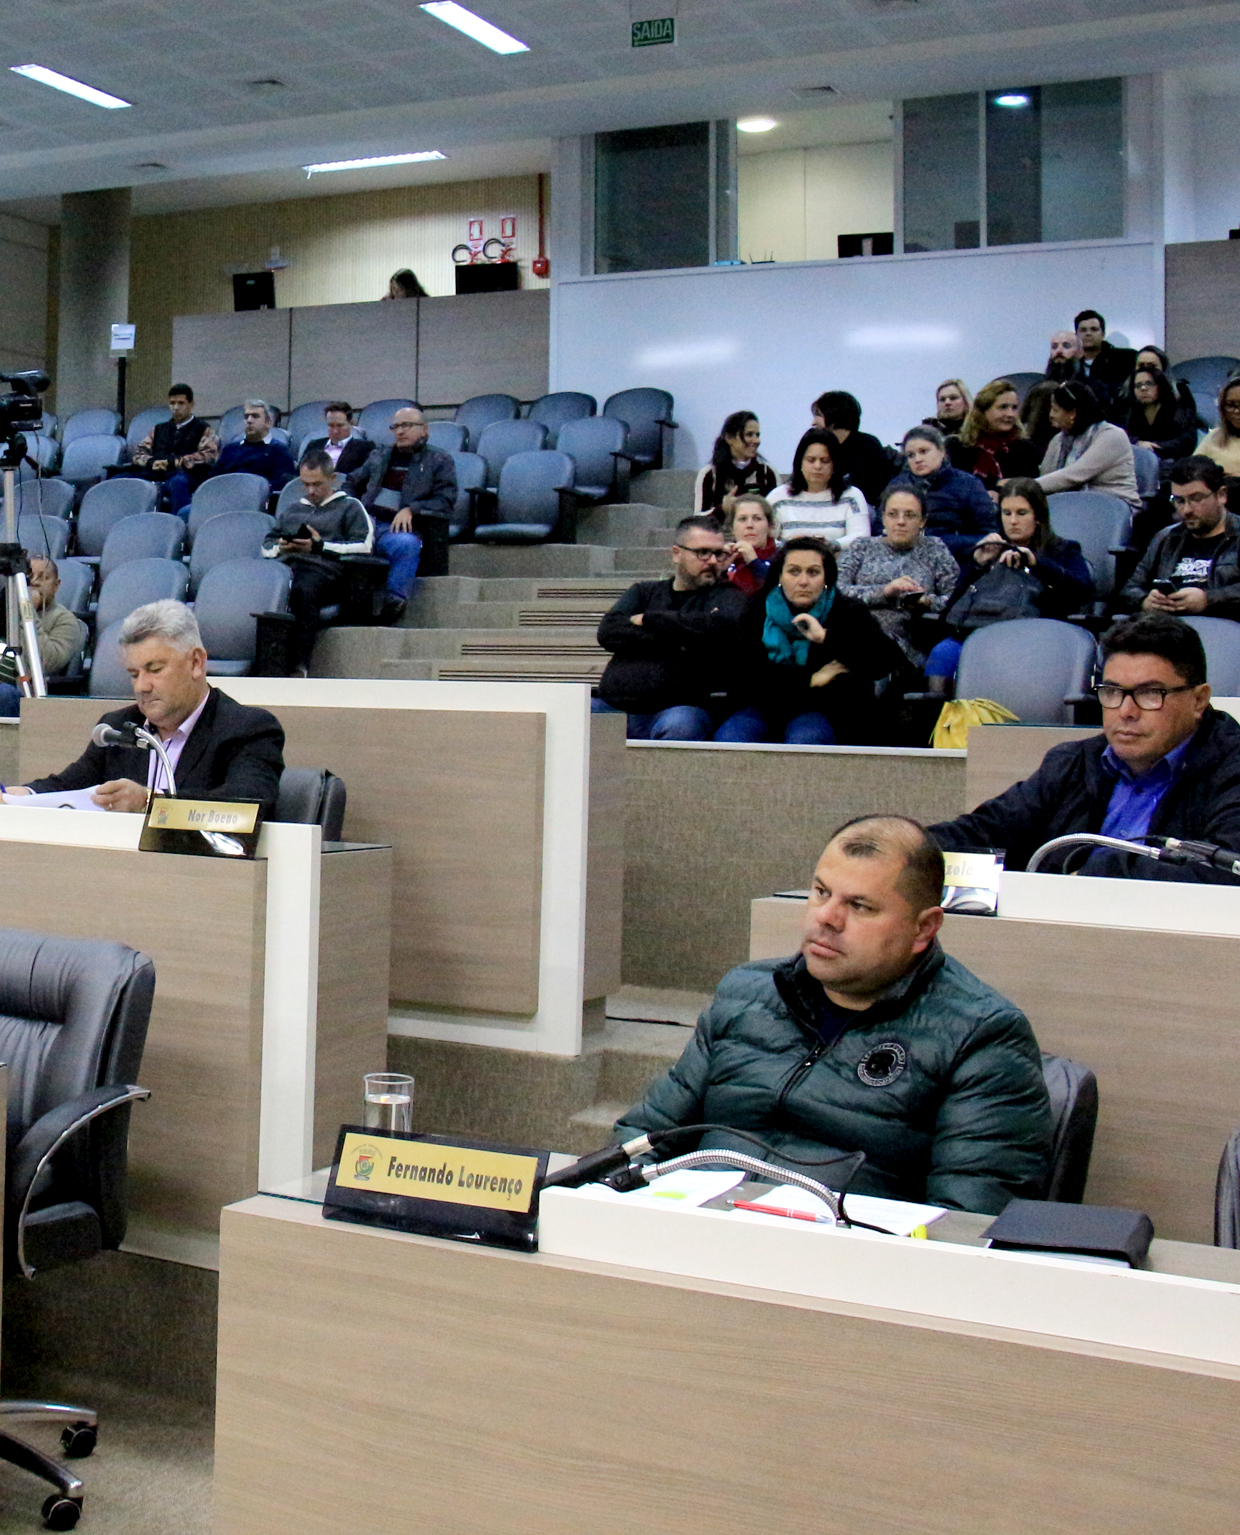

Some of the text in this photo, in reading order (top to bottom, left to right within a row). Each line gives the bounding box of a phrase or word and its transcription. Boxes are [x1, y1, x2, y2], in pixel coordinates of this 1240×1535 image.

[188, 809, 238, 824] Nor Boeno
[387, 1156, 523, 1201] Fernando Lourenço
